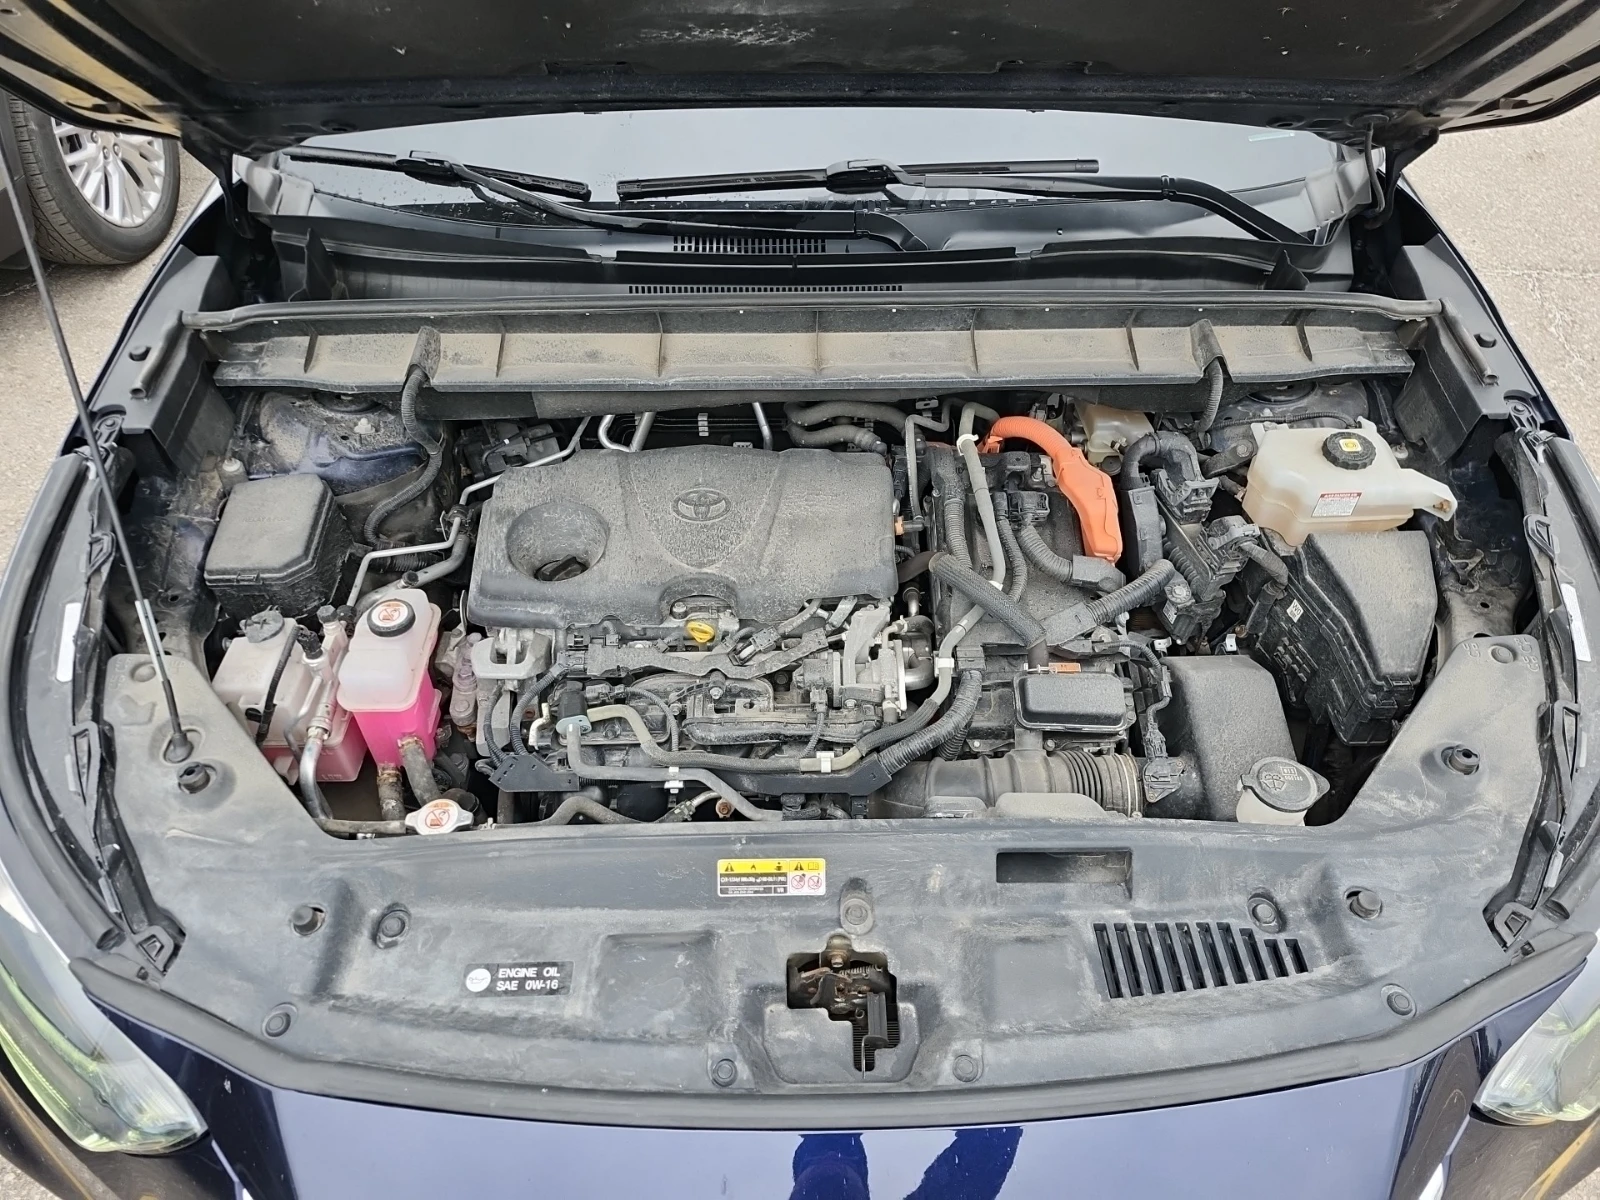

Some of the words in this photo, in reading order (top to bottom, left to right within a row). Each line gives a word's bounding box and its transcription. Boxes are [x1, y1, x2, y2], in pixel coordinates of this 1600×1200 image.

[498, 968, 538, 978] ENGINE
[543, 967, 561, 977] OIL
[496, 980, 519, 991] SAE
[525, 979, 559, 990] 0W-16
